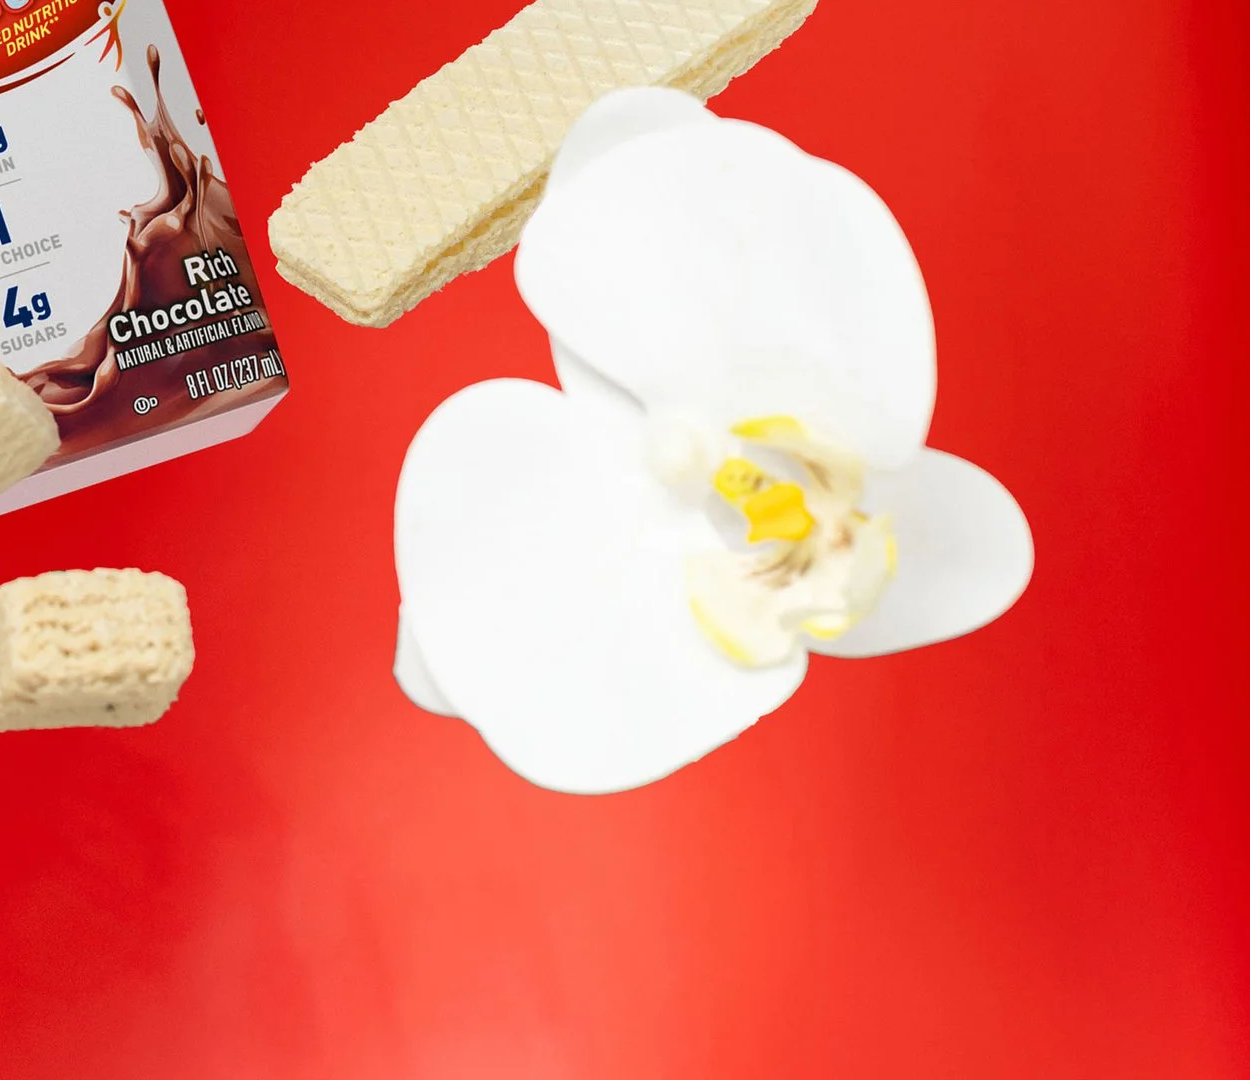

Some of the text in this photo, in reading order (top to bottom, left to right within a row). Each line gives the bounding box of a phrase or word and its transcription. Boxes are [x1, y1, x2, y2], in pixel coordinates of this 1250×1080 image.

[0, 234, 62, 265] CHOICE
[184, 250, 238, 286] Rich
[3, 285, 51, 328] 4g
[109, 284, 252, 343] Chocolate
[0, 322, 67, 355] SUGARS
[116, 341, 165, 370] NATURAL
[165, 337, 176, 356] &
[176, 321, 232, 351] ARTIFICIAL
[185, 349, 285, 399] 8 FL OZ (237 mL)
